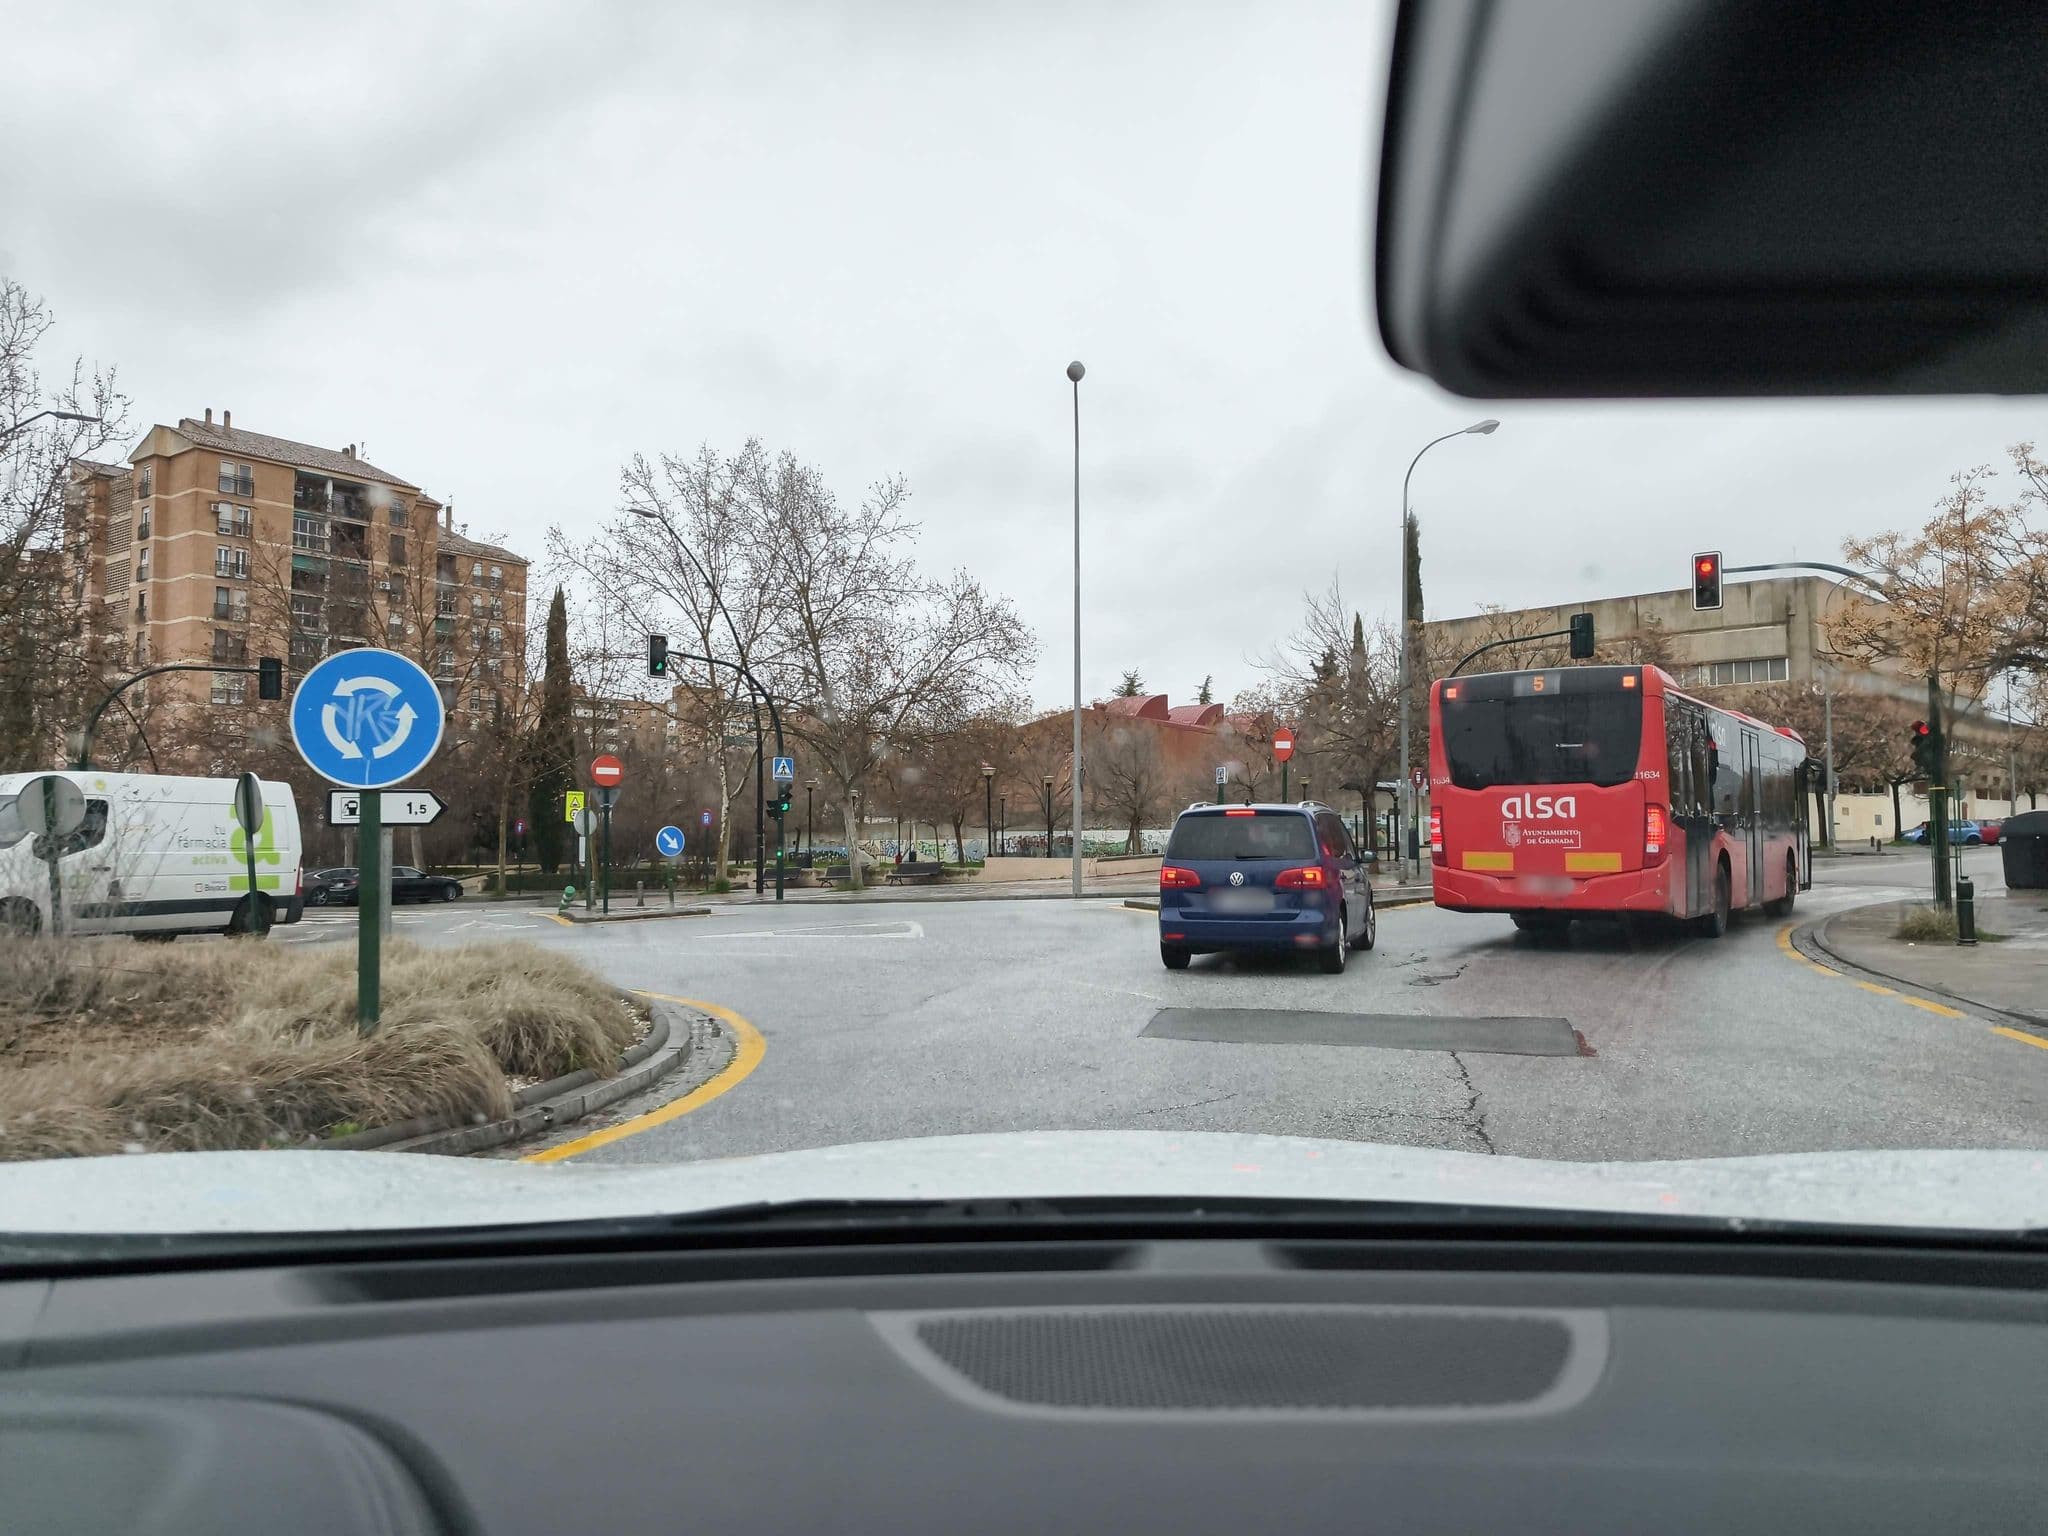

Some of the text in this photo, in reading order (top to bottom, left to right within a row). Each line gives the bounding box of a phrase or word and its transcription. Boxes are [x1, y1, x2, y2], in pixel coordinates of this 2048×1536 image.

[1533, 676, 1545, 691] 5
[1635, 770, 1660, 779] 11634
[406, 802, 427, 815] 1,5
[1501, 792, 1576, 819] alsa
[1522, 828, 1579, 837] AYUNTAMIENTO
[1538, 836, 1574, 845] GRANADA
[192, 855, 228, 865] activa
